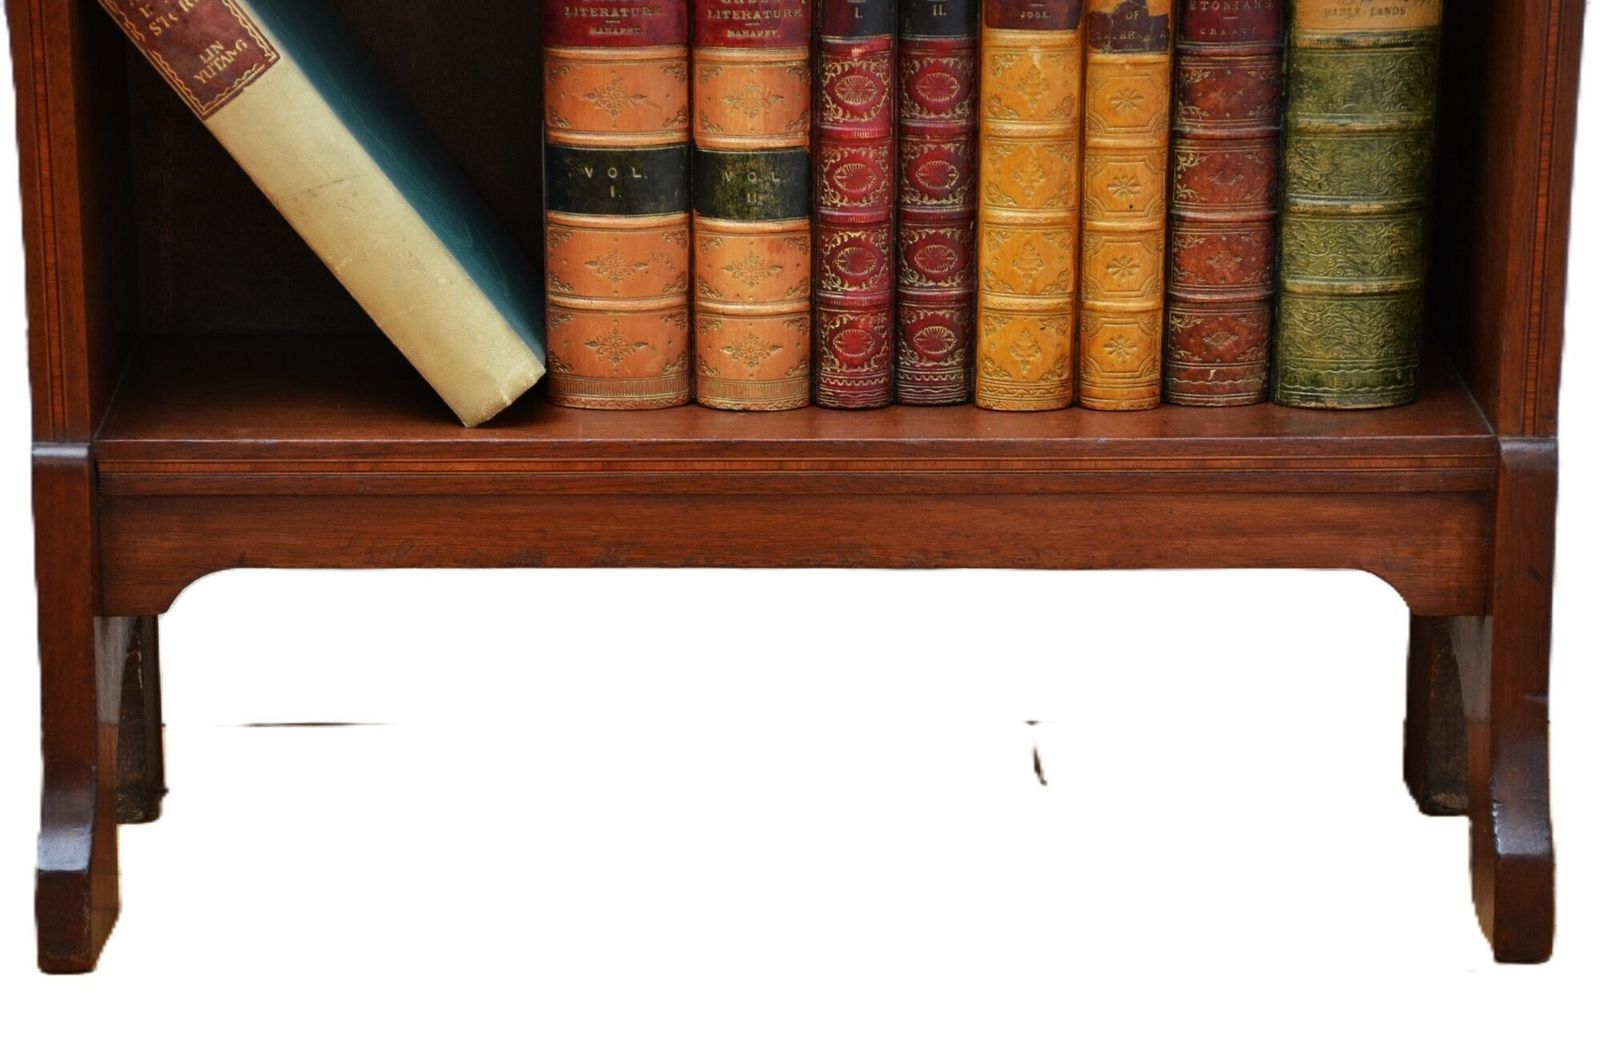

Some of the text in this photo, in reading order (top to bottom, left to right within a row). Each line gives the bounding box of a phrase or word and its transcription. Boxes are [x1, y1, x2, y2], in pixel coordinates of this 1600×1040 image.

[564, 6, 662, 17] LITERATURE
[707, 8, 803, 20] LITERATURE
[193, 38, 248, 84] YUTANG
[200, 40, 224, 64] LIN
